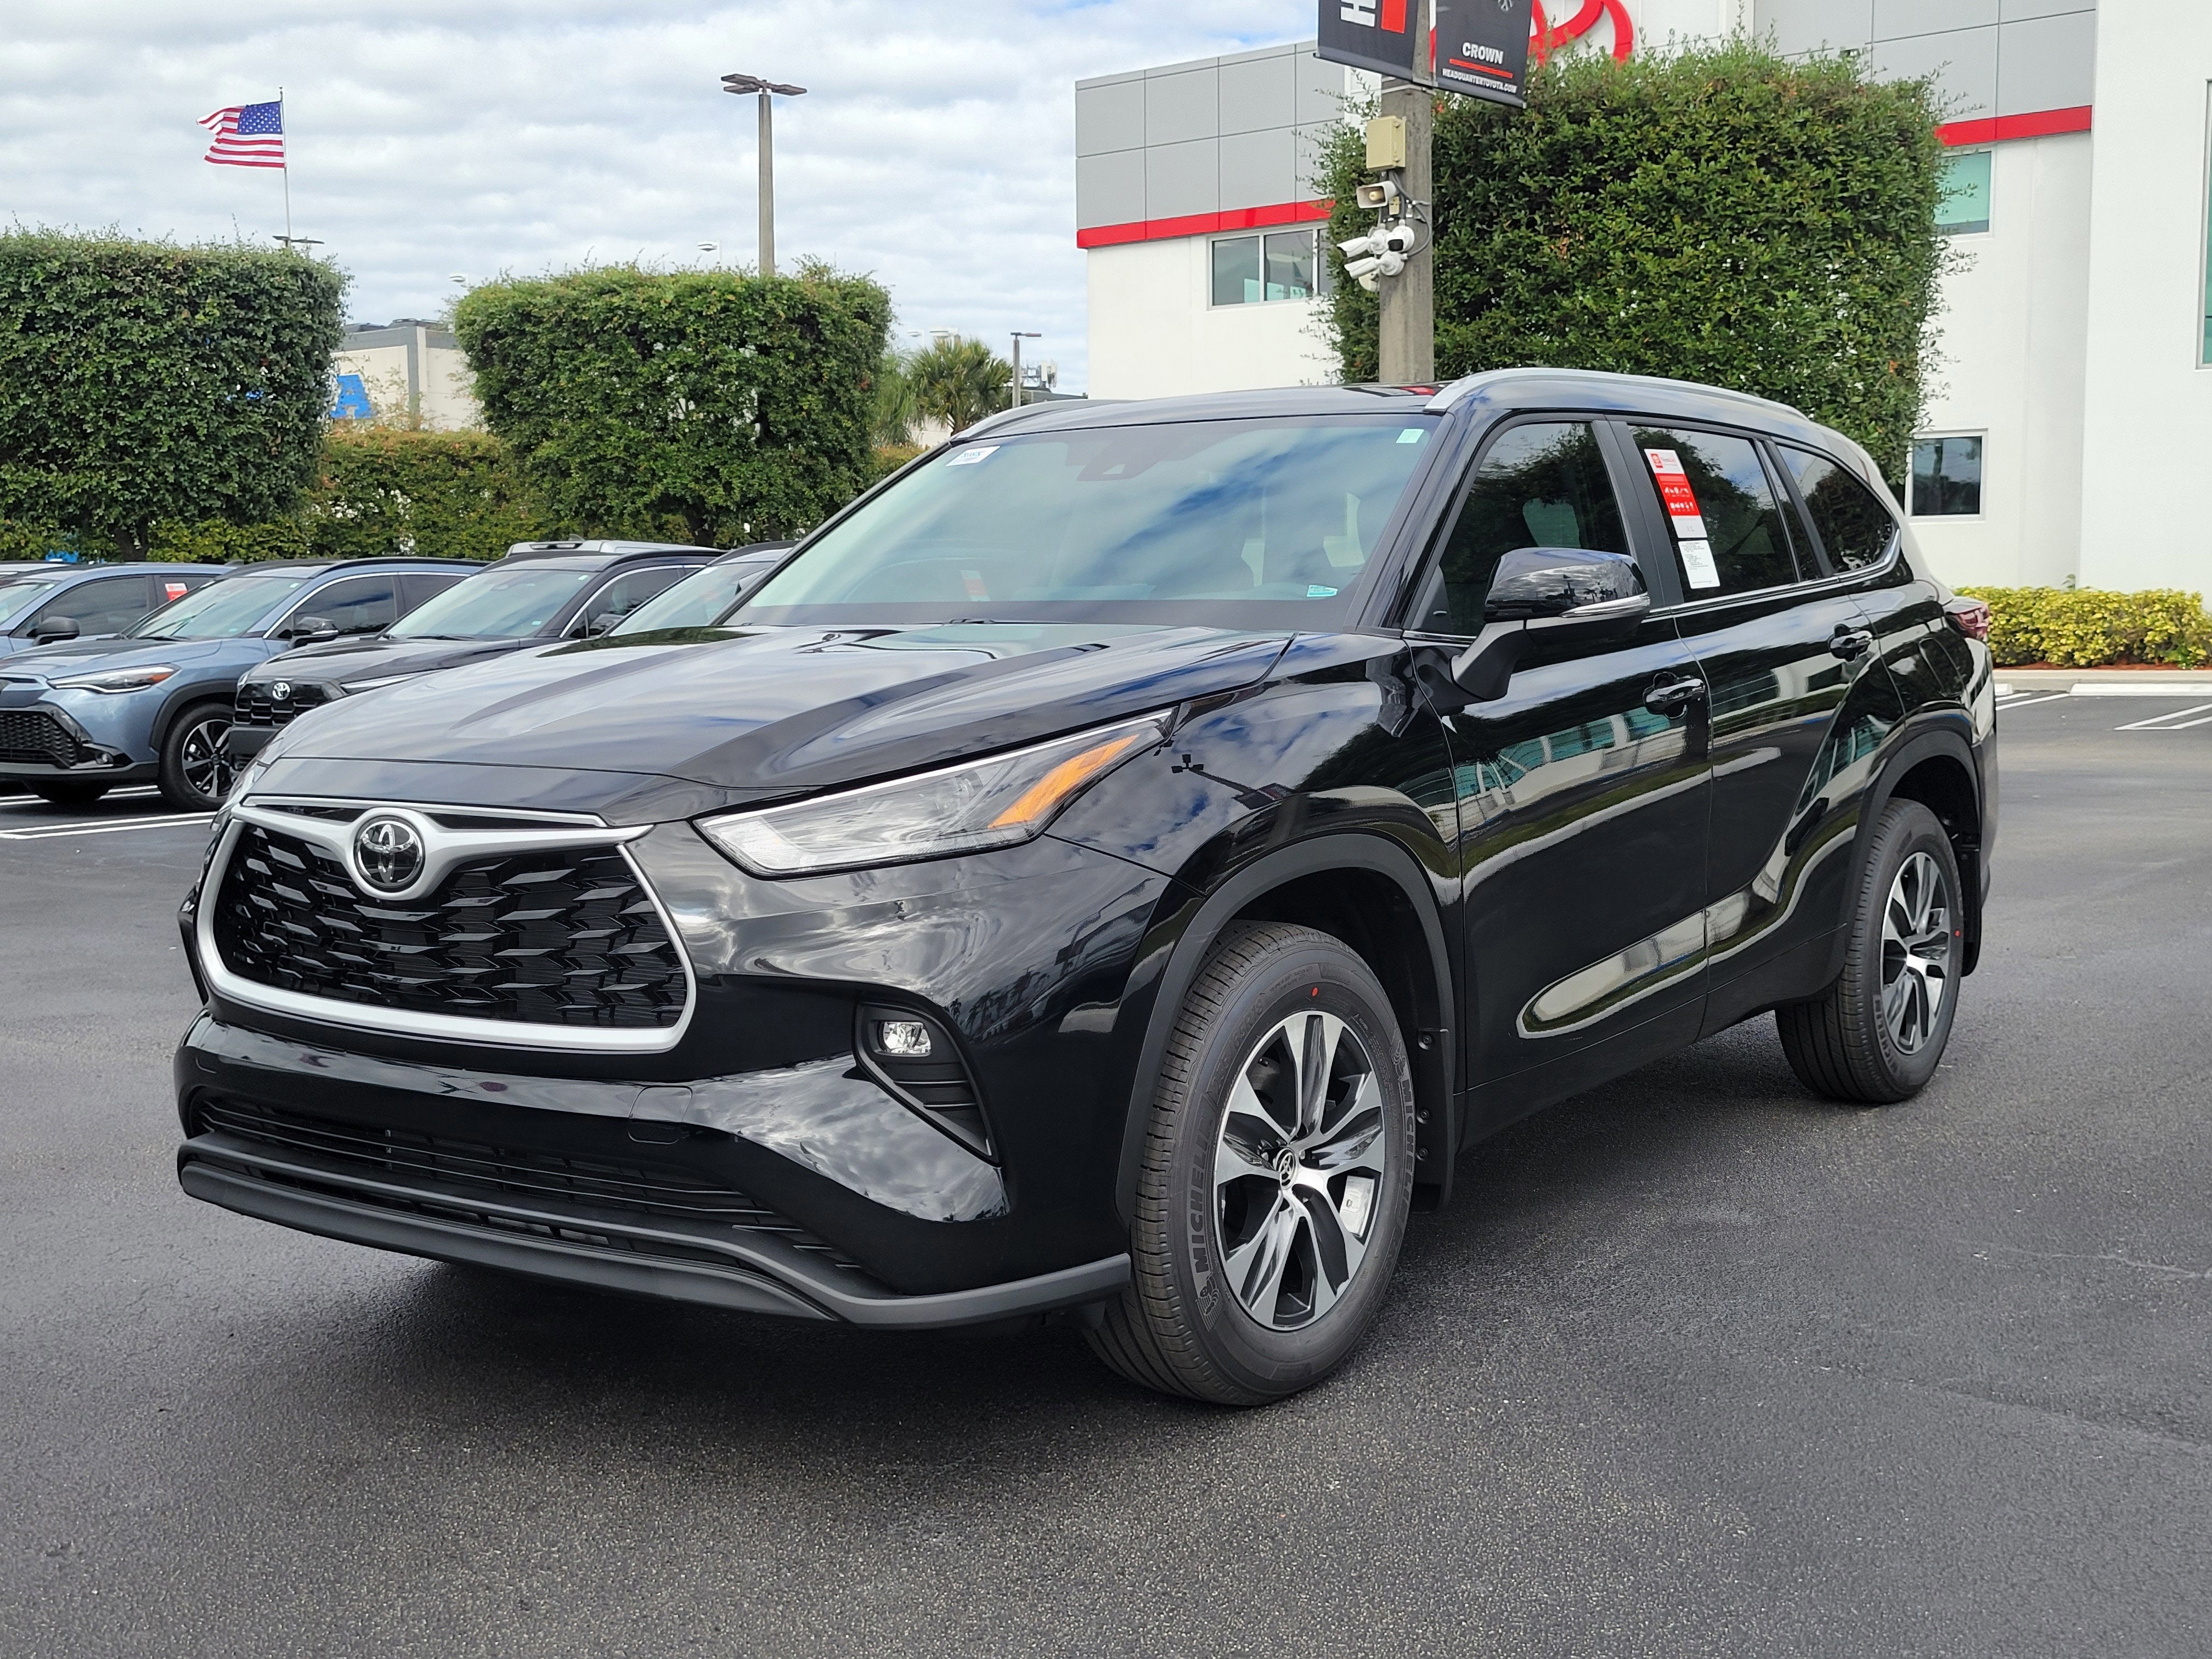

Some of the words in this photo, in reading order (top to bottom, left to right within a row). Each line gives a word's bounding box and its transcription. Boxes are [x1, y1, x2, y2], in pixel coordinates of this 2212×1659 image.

[1462, 42, 1504, 65] CROWN
[1190, 1103, 1213, 1273] MICHELIN
[1399, 1079, 1414, 1223] MICHELIN
